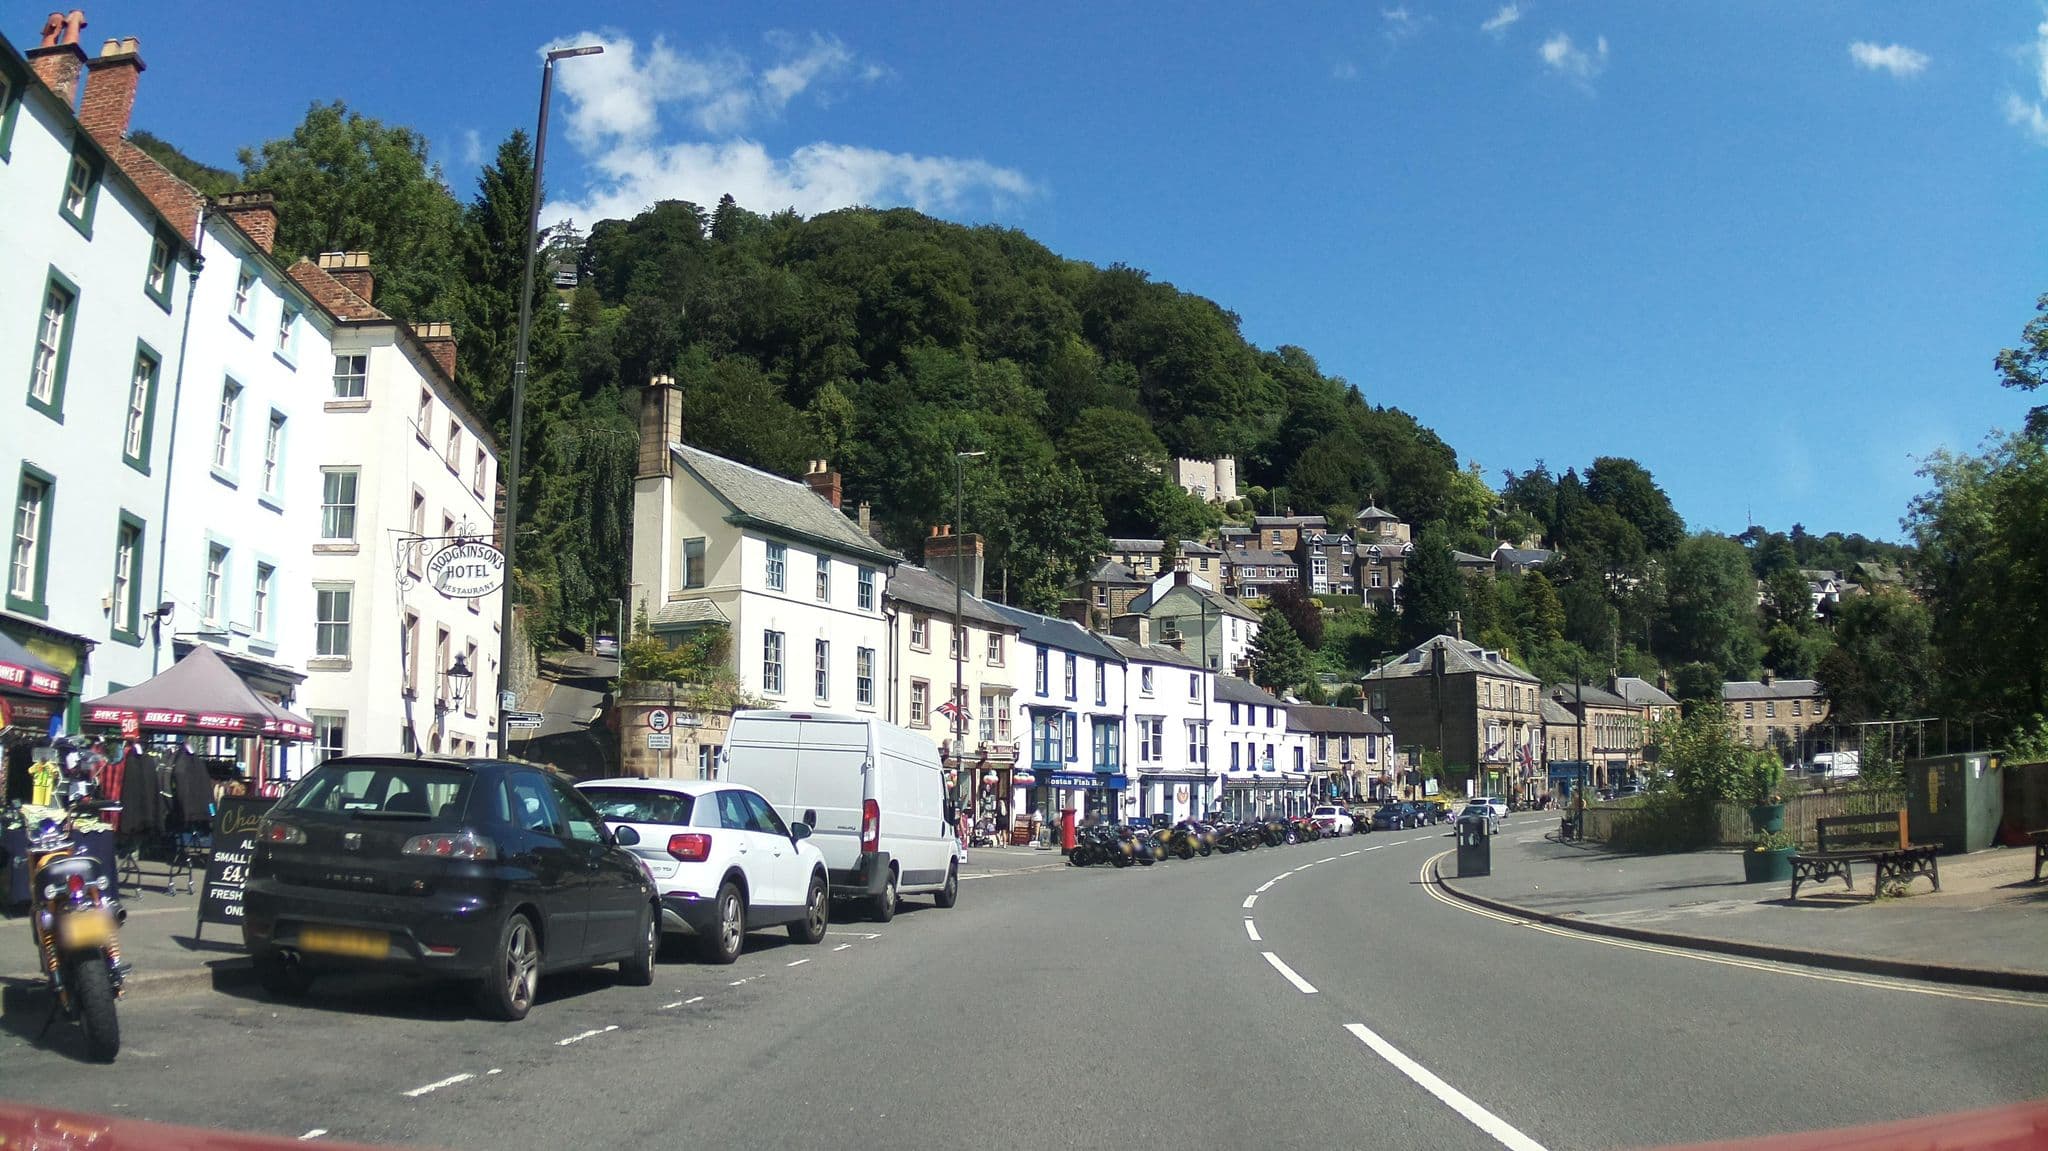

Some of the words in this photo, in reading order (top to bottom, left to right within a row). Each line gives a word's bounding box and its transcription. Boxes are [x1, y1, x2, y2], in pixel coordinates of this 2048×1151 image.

[431, 545, 505, 572] HODGKINSON'S
[446, 564, 490, 578] HOTEL
[442, 581, 495, 594] RESTAURANT
[94, 710, 120, 721] BIKE
[144, 712, 172, 722] BIKE
[172, 713, 186, 724] IT
[199, 716, 229, 727] BIKE
[228, 717, 243, 727] IT
[1073, 778, 1090, 786] Fish
[214, 851, 247, 864] SMALL
[210, 889, 243, 901] FRESH
[224, 905, 245, 917] ONL
